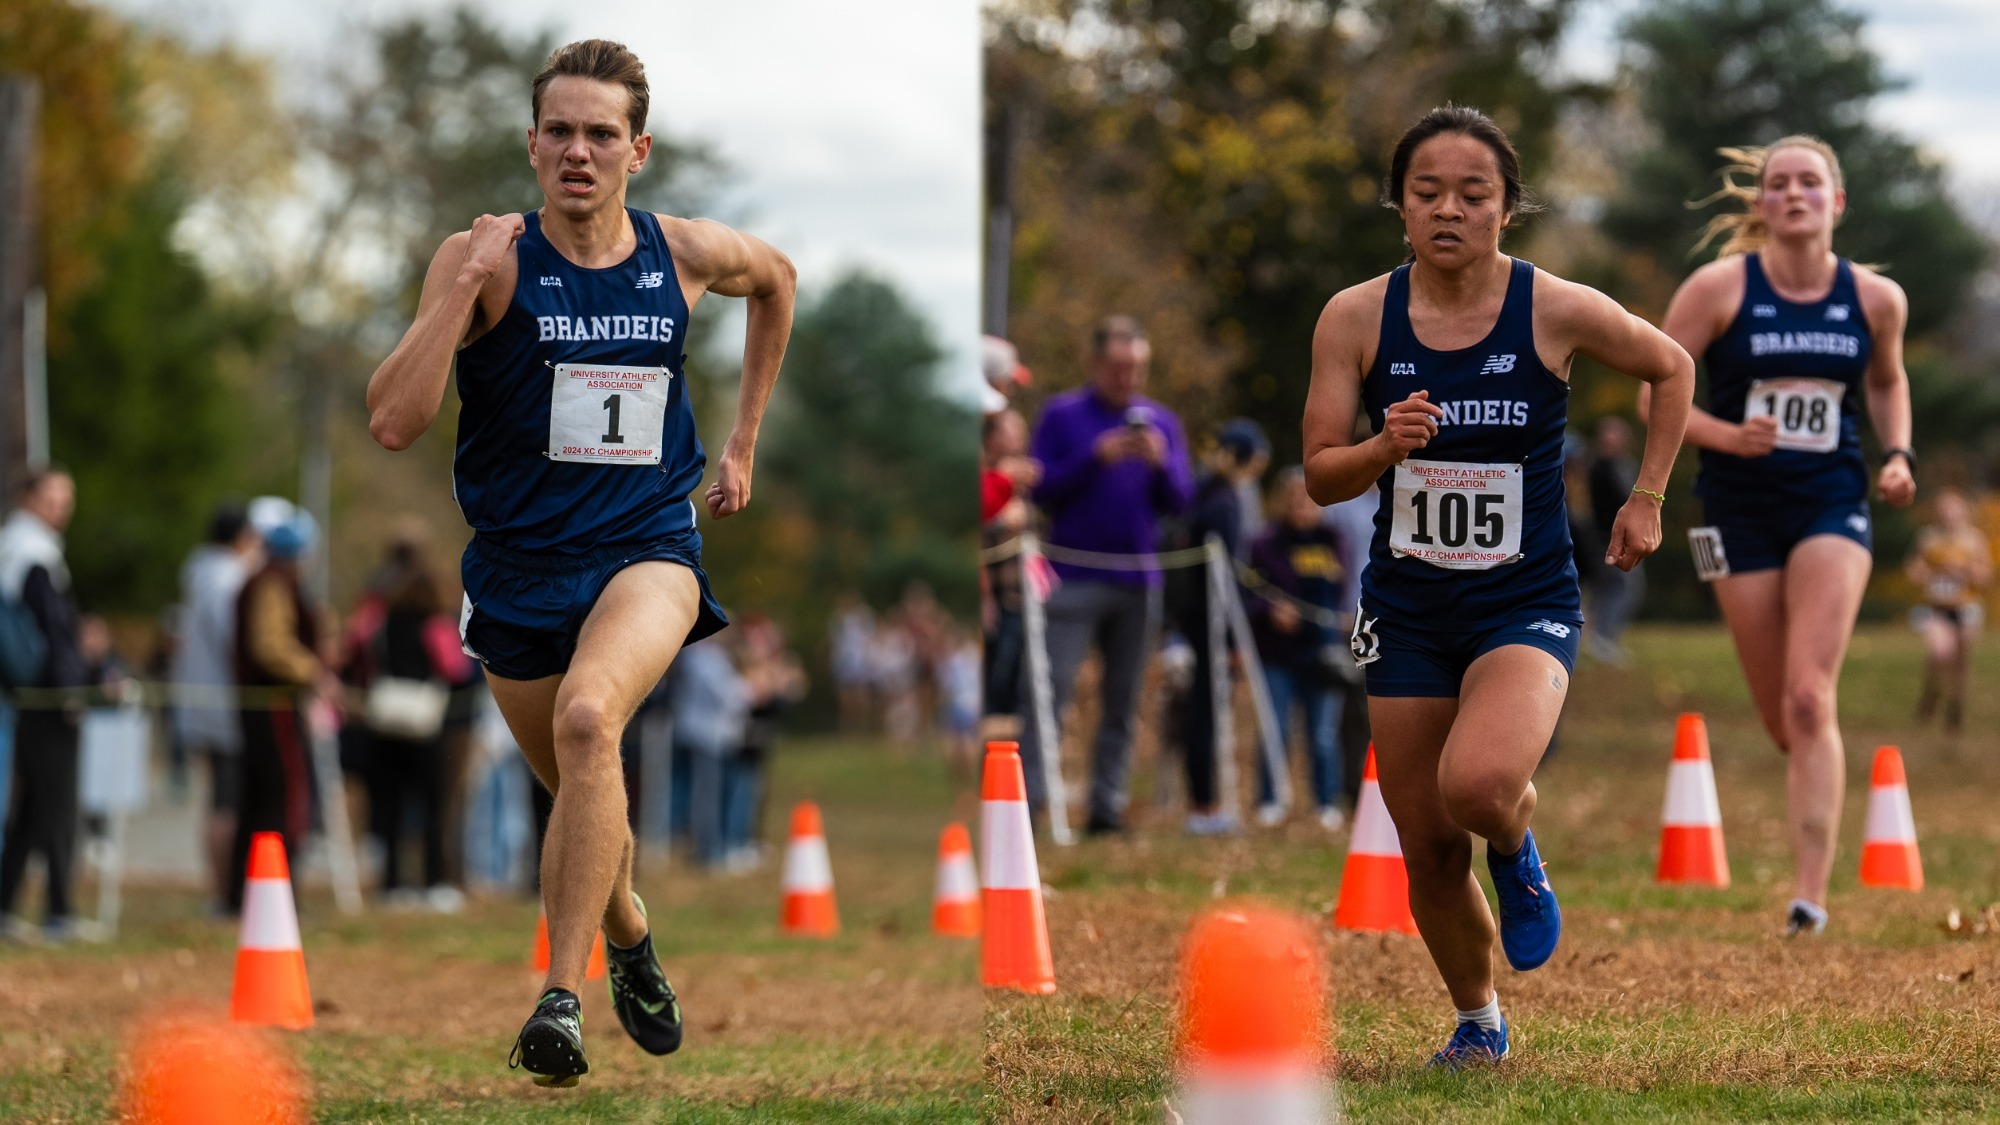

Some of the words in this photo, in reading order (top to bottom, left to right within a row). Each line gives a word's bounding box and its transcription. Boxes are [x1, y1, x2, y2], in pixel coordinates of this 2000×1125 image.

[540, 276, 563, 288] UAA
[537, 315, 674, 343] BRANDEIS
[1749, 332, 1859, 357] BRANDEIS
[1390, 362, 1416, 375] UAA
[1480, 354, 1517, 375] NB
[570, 370, 620, 379] UNIVERSITY
[622, 372, 658, 380] ATHLETIC
[587, 381, 643, 389] ASSOCIATION
[602, 394, 624, 443] 1
[1383, 400, 1529, 426] NDEIS
[1765, 392, 1827, 434] 108
[563, 446, 582, 454] 2024
[584, 447, 595, 455] XC
[597, 448, 653, 457] CHAMPIONSHIP
[1410, 466, 1459, 477] UNIVERSITY
[1461, 469, 1506, 478] ATHLETIC
[1425, 479, 1487, 488] ASSOCIATION
[1411, 491, 1505, 548] 105
[1424, 550, 1436, 558] XC
[1438, 552, 1507, 561] CHAMPIONSHIP
